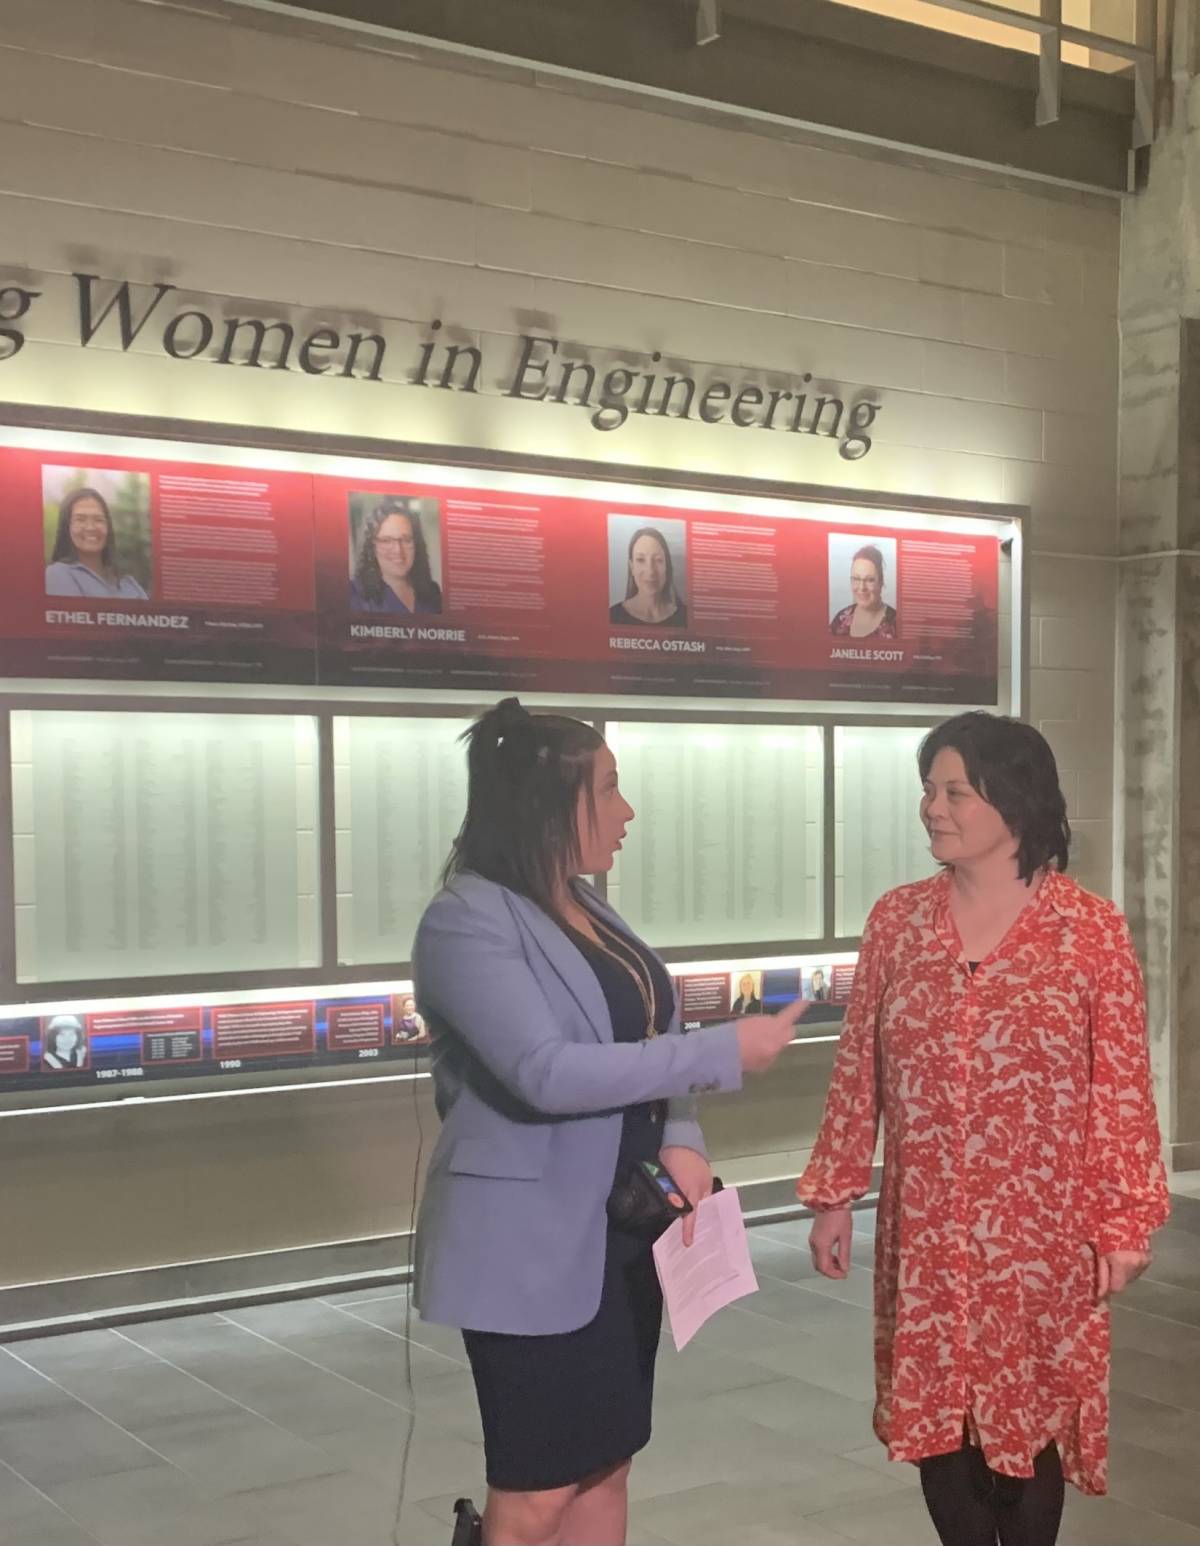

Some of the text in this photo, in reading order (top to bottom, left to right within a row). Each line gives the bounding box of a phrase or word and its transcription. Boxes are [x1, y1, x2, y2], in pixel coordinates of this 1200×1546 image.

[72, 272, 387, 382] Women
[411, 318, 482, 393] in
[501, 335, 882, 461] Engineering
[45, 610, 95, 625] ETHEL
[97, 612, 189, 629] FERNANDEZ
[350, 625, 416, 639] KIMBERLY
[417, 628, 466, 642] NORRIE
[609, 637, 661, 651] REBECCA
[662, 640, 706, 652] OSTASH
[829, 647, 872, 661] JANELLE
[873, 650, 904, 661] SCOTT
